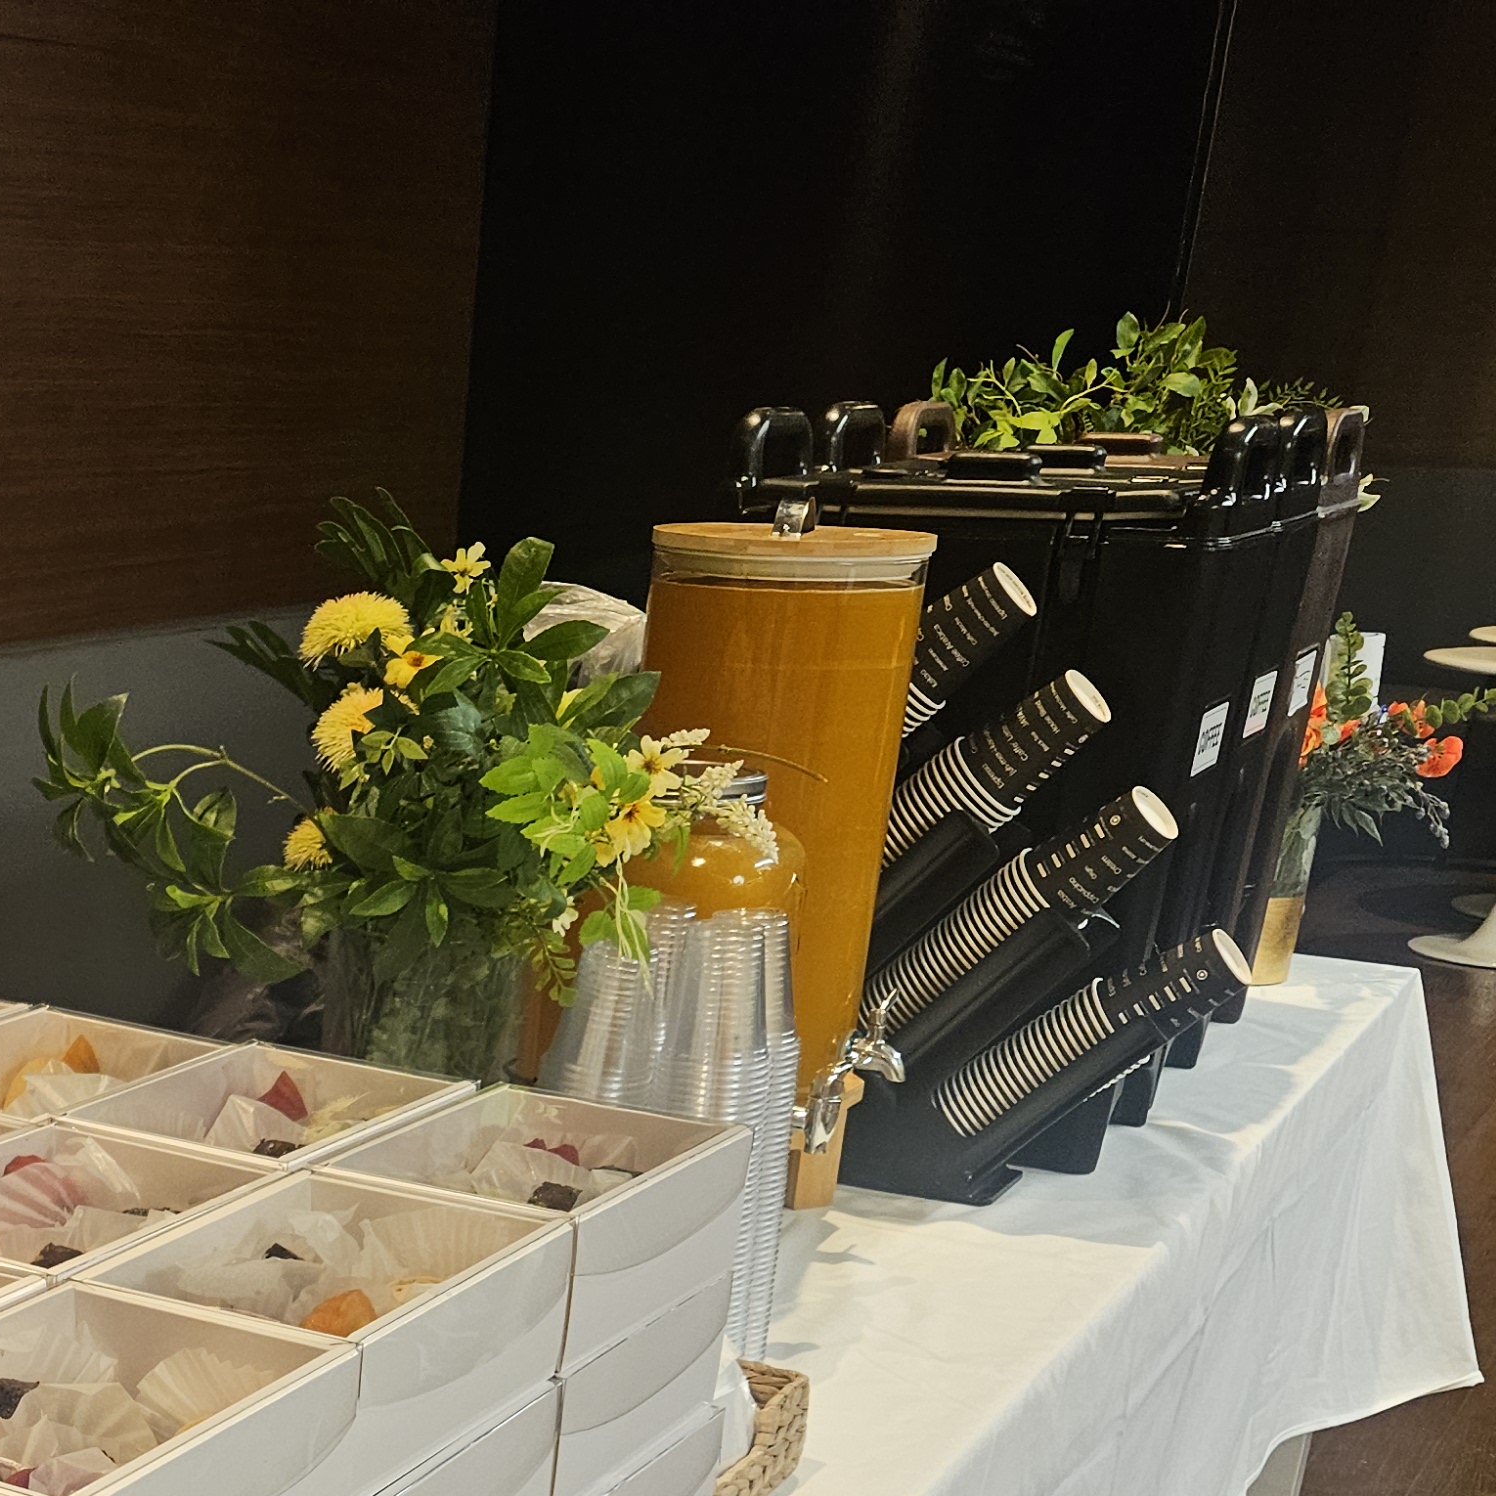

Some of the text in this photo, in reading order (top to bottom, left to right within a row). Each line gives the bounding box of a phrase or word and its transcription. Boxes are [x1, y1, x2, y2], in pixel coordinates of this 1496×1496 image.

[933, 624, 953, 649] Arabica
[951, 648, 970, 668] Coffee
[1249, 689, 1271, 718] COFFEE
[1197, 722, 1223, 756] COFFEE
